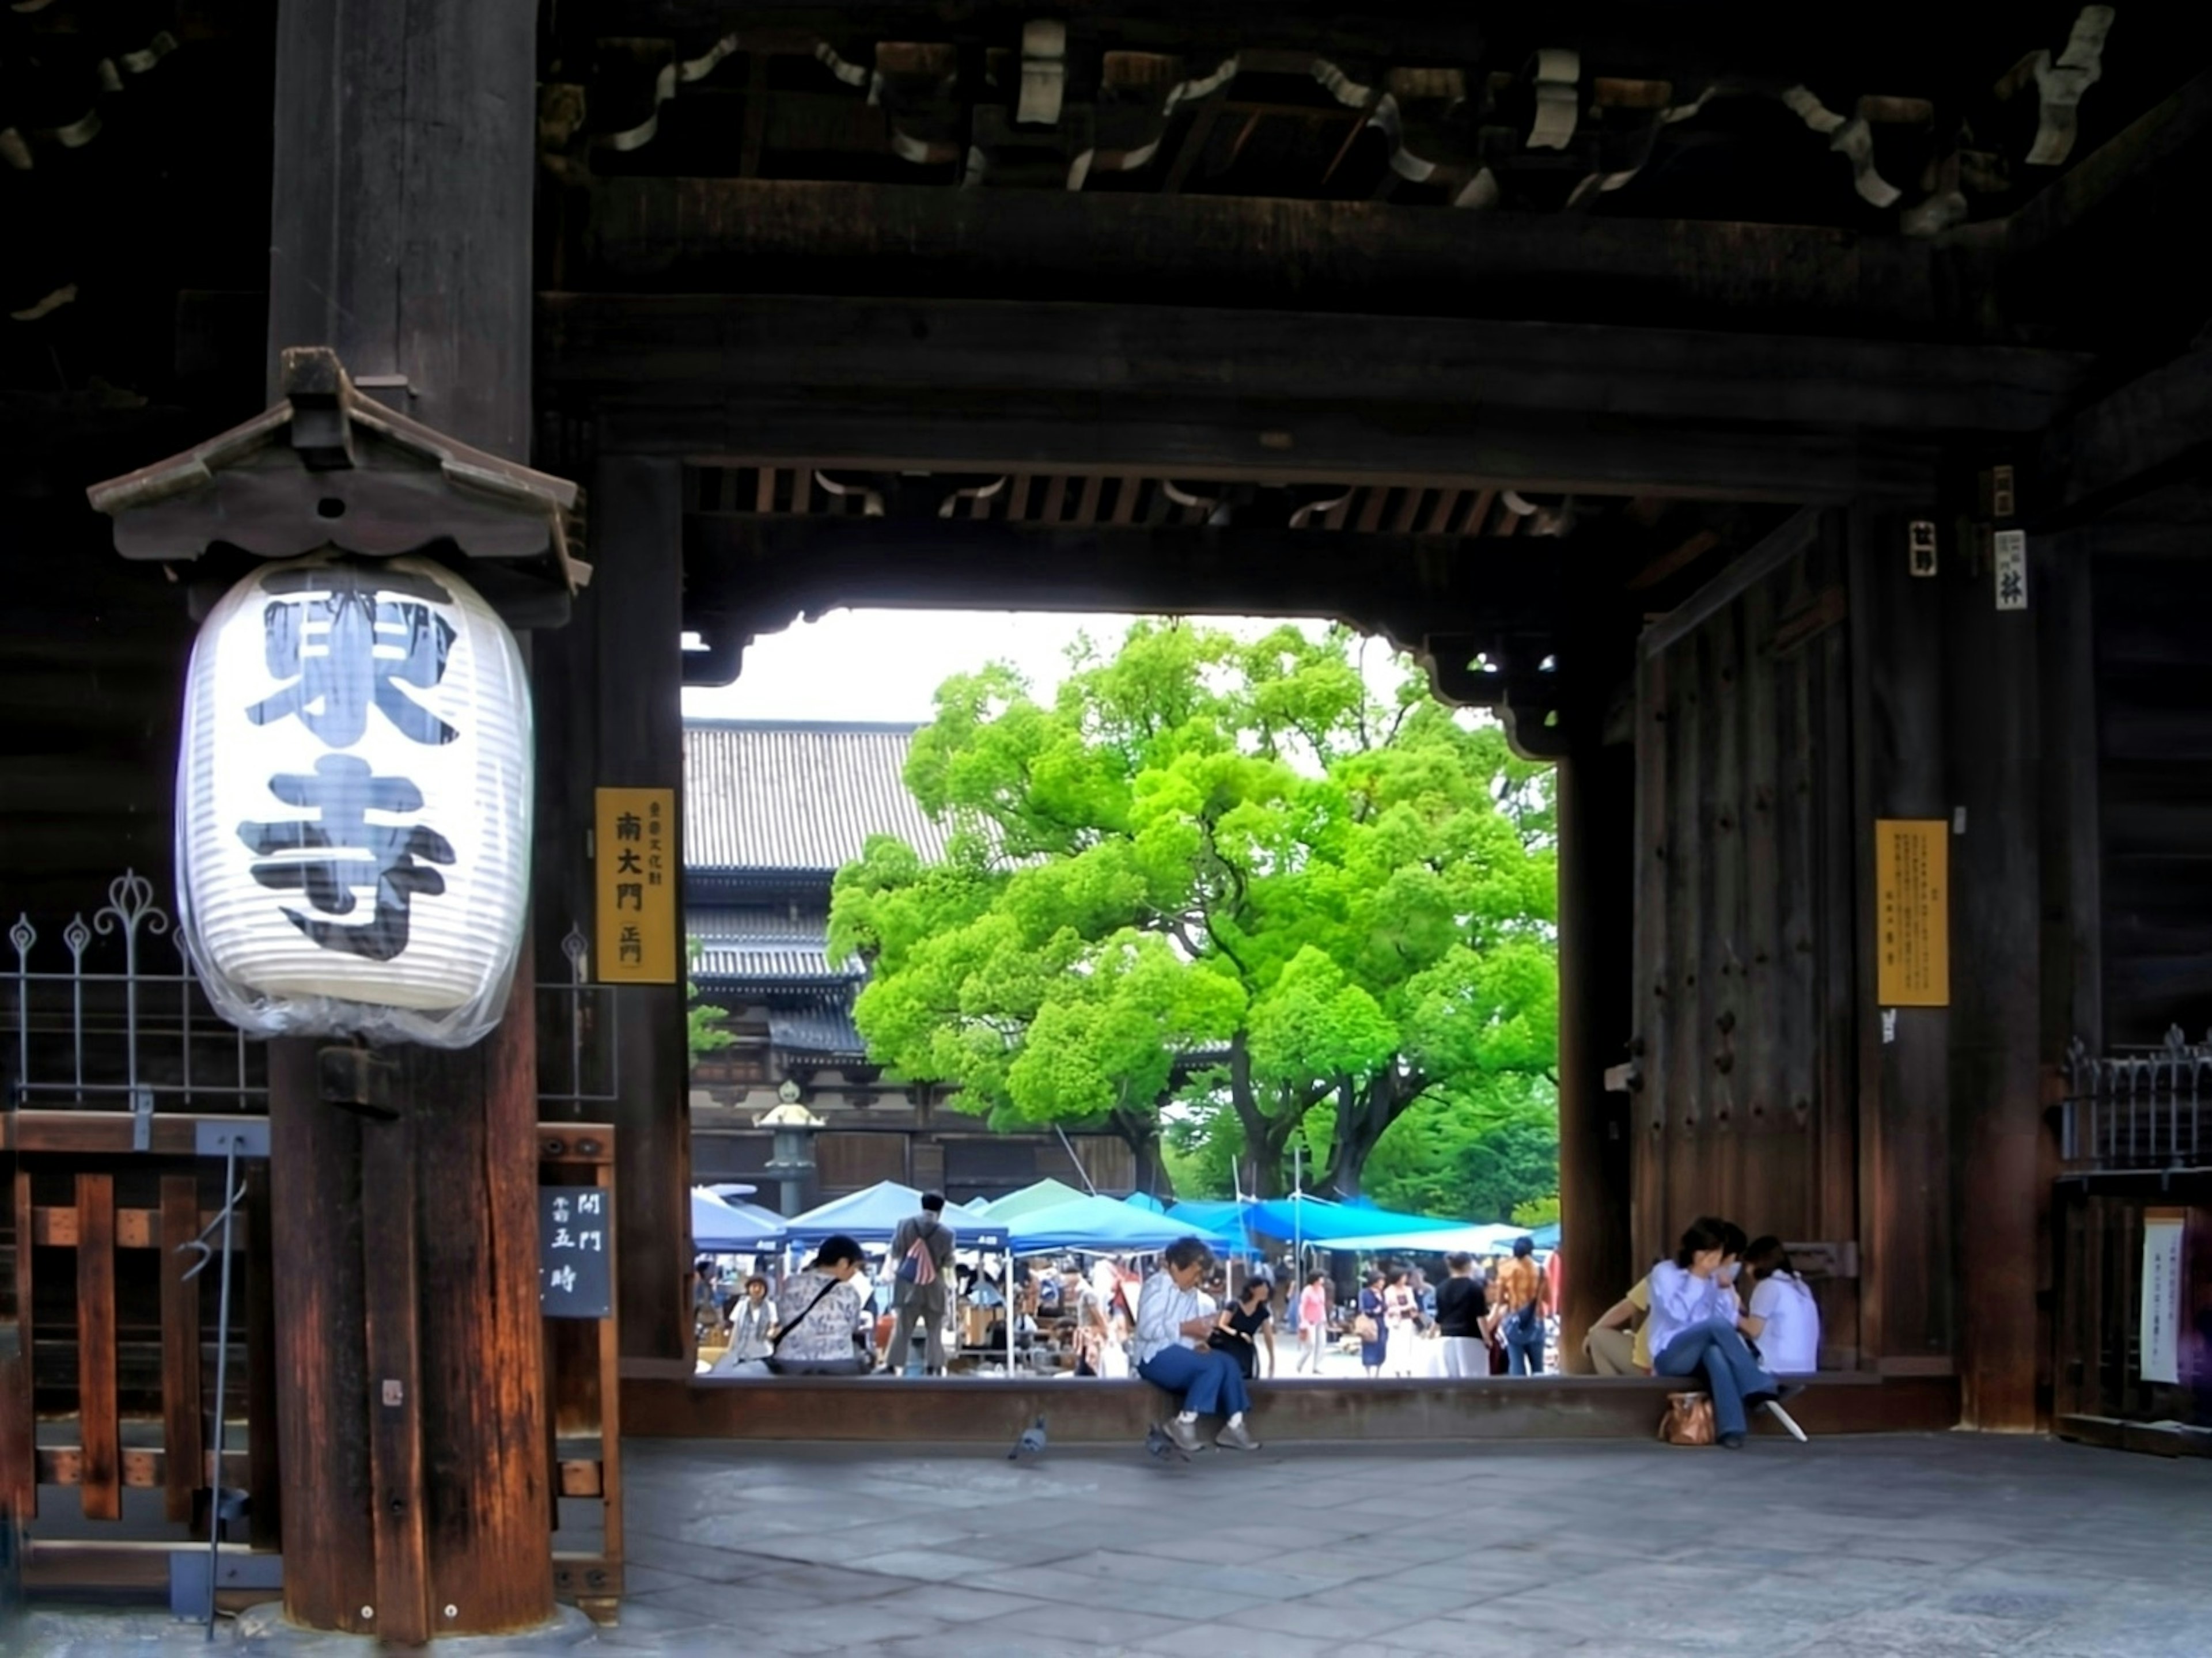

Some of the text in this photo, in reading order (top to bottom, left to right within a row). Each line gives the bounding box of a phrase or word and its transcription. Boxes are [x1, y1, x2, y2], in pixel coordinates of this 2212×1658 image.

[236, 568, 463, 962] 東寺
[616, 811, 642, 910] 南大門
